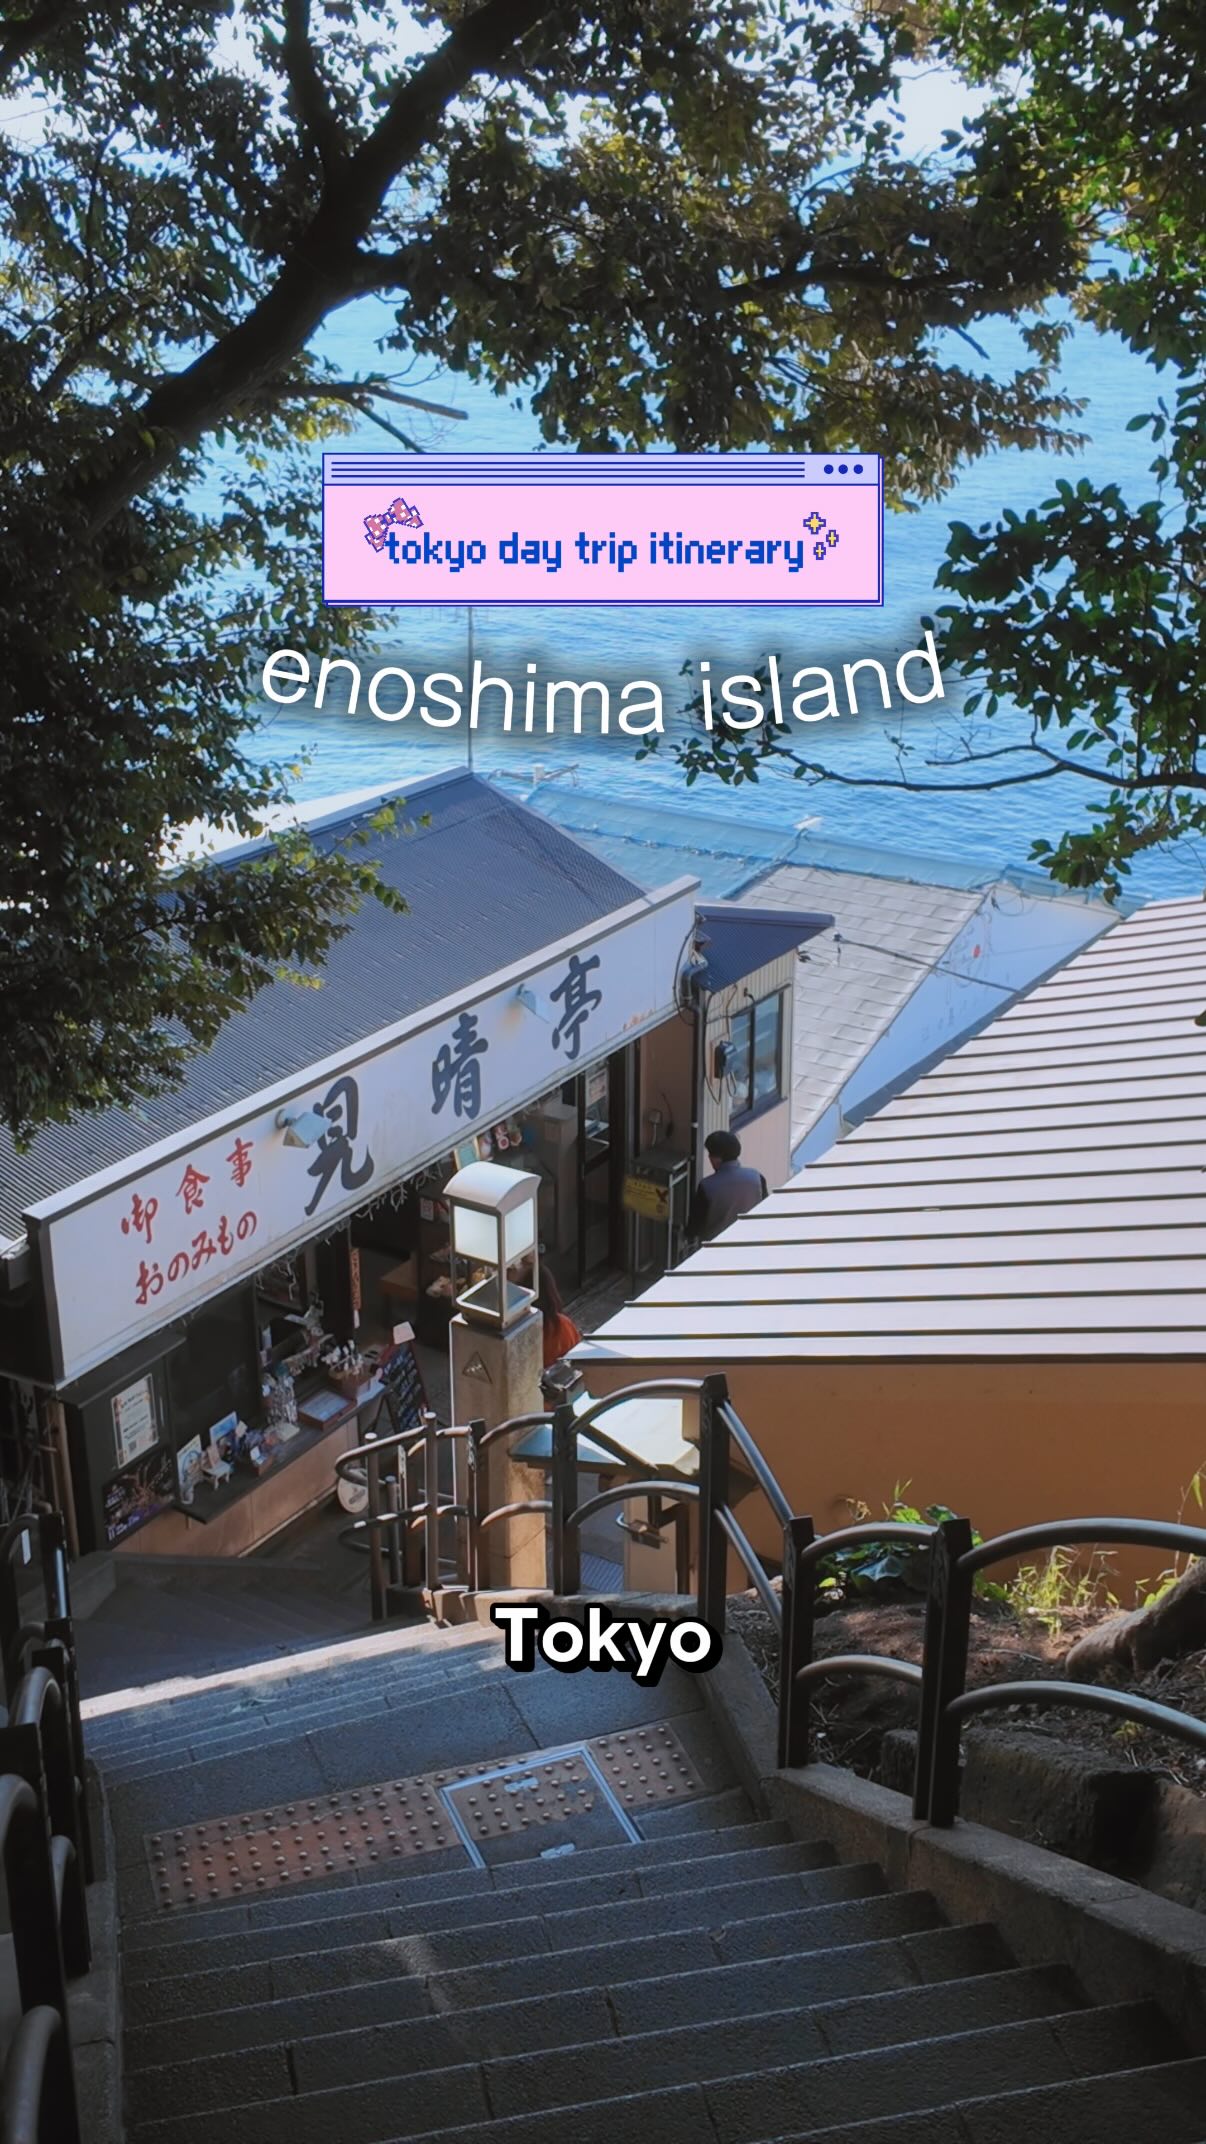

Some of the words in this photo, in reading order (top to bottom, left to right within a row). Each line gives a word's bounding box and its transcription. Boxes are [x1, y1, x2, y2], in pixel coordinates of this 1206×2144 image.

[121, 1137, 253, 1244] 御食事
[135, 1211, 257, 1305] おのみもの
